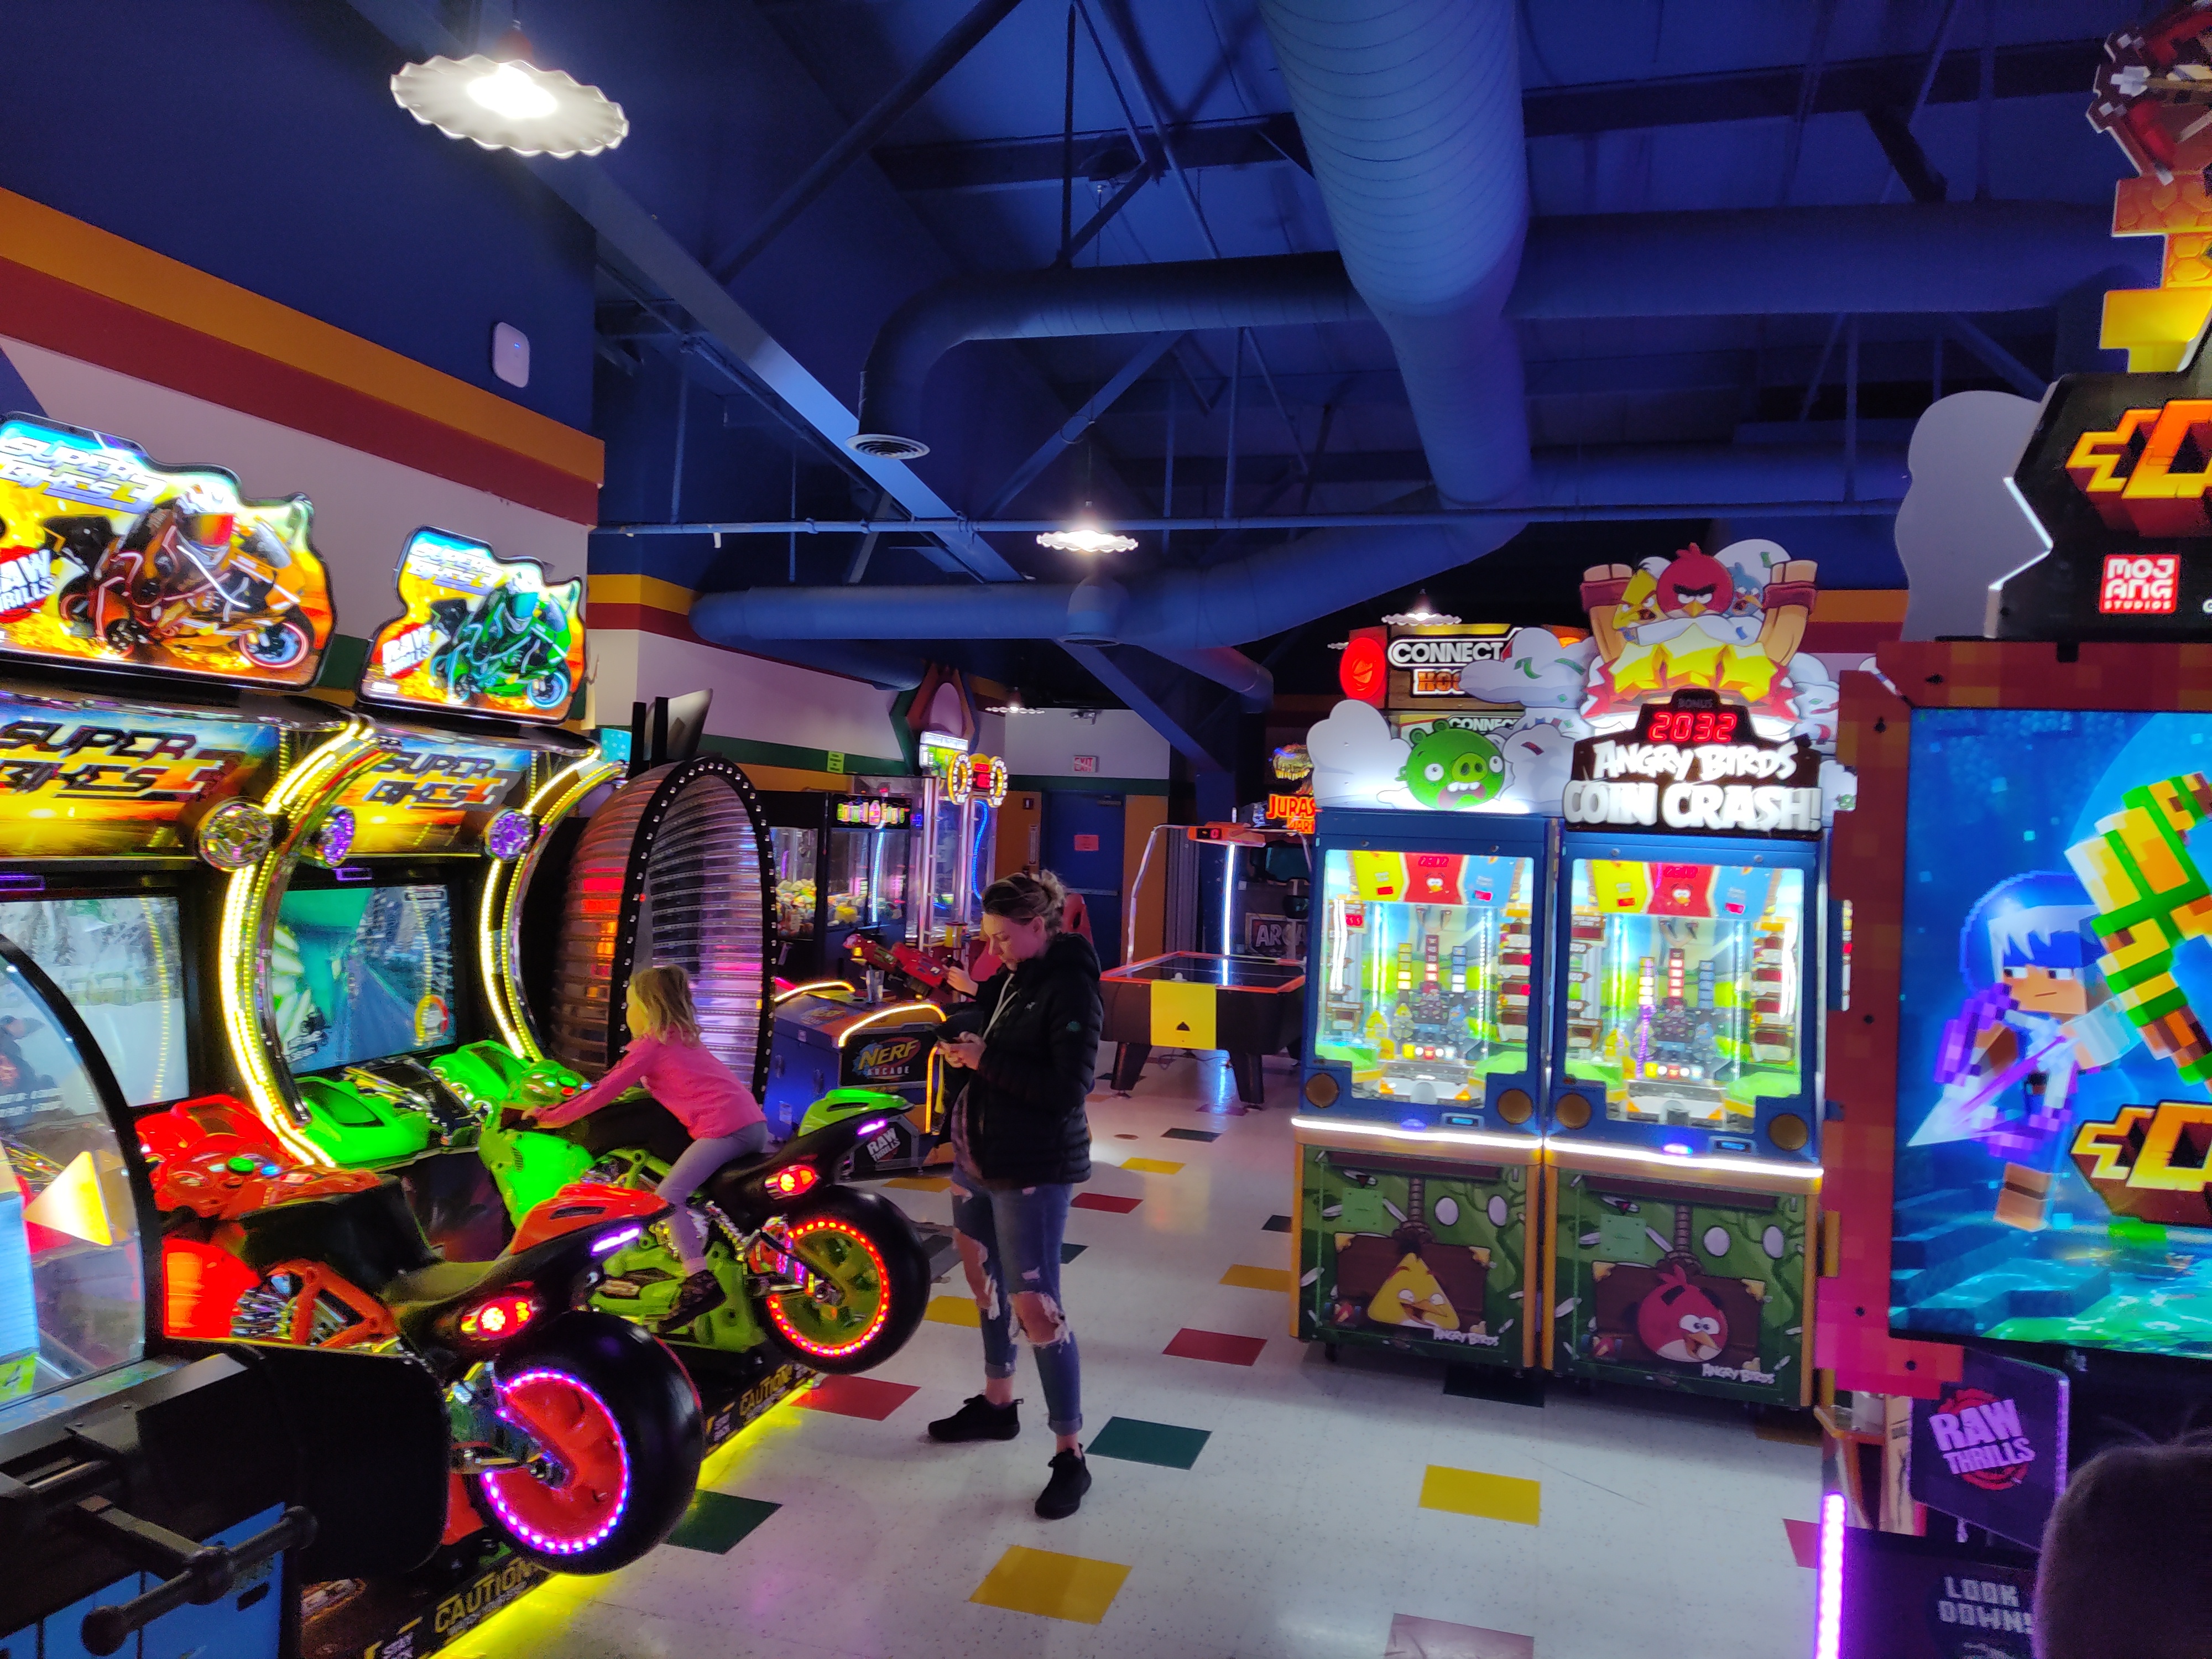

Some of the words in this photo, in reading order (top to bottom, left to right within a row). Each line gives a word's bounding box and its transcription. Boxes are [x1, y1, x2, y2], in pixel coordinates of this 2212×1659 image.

[2107, 559, 2176, 578] MOJ
[0, 577, 56, 612] RILLS
[2104, 601, 2172, 610] STUDIOS
[1396, 643, 1504, 663] CONNECT
[1648, 713, 1738, 743] 2032
[1074, 757, 1093, 772] EXIT
[1593, 740, 1694, 781] ANGRY
[1694, 740, 1799, 781] BIRDS
[1563, 780, 1658, 826] COIN
[1662, 782, 1822, 832] CRASH!
[857, 1040, 919, 1071] NERF
[867, 1066, 910, 1076] ARCADE
[866, 1127, 896, 1156] RAW
[1433, 1327, 1469, 1343] ANGRY
[1468, 1332, 1499, 1347] BIRDS
[1702, 1363, 1740, 1380] ANGRY
[1739, 1369, 1776, 1384] BIRDS
[1929, 1399, 2022, 1451] RAW
[1942, 1438, 2036, 1475] THRILLS
[1943, 1576, 2020, 1607] LOOK
